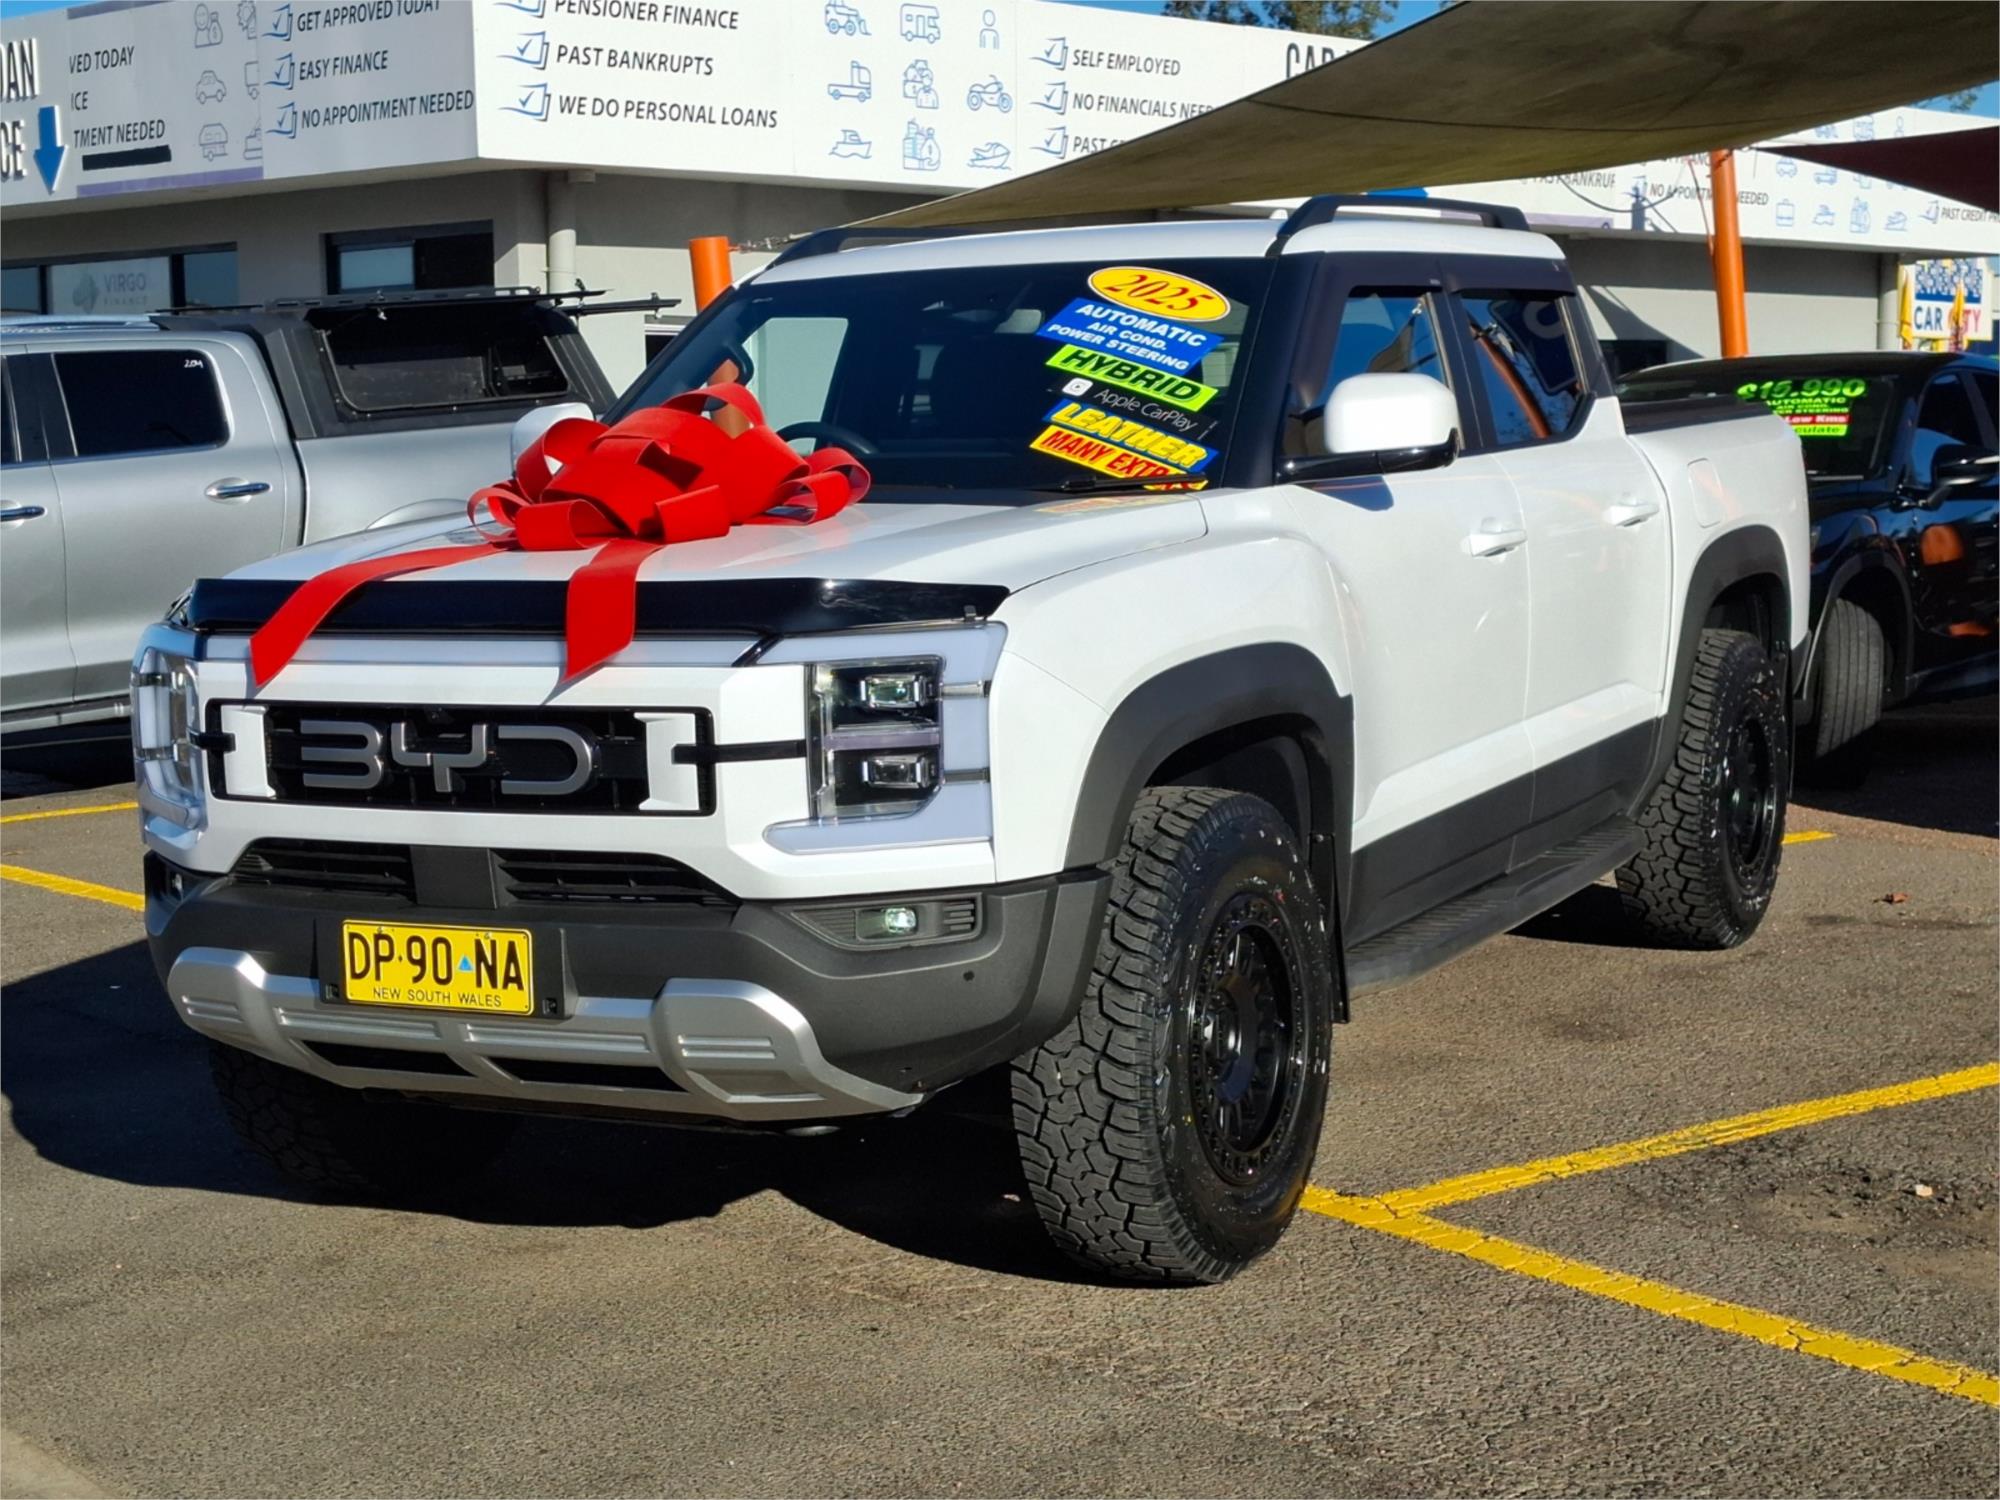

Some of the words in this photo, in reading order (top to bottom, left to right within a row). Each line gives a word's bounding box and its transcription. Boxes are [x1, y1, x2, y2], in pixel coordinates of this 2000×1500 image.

[297, 11, 320, 31] GET
[323, 1, 393, 28] APPROVED
[555, 0, 659, 22] PENSIONER
[663, 5, 740, 30] FINANCE
[95, 46, 134, 69] TODAY
[299, 59, 330, 81] EASY
[333, 50, 389, 76] FINANCE
[556, 44, 604, 66] PAST
[607, 49, 714, 76] BANKRUPTS
[1073, 49, 1105, 68] SELF
[1107, 53, 1181, 76] EMPLOYED
[302, 109, 321, 129] NO
[323, 97, 417, 126] APPOINTMENT
[419, 90, 475, 115] NEEDED
[559, 95, 588, 115] WE
[591, 97, 620, 118] DO
[624, 100, 717, 124] PERSONAL
[721, 107, 778, 129] LOANS
[1073, 93, 1094, 111] NO
[1097, 95, 1177, 118] FINANCIALS
[74, 125, 113, 148] TMENT
[116, 119, 165, 143] NEEDED
[1650, 183, 1665, 197] NO
[1941, 207, 1961, 220] PAST
[104, 272, 146, 292] VIRGO
[1104, 274, 1214, 311] 2025
[1075, 304, 1207, 347] AUTOMATIC
[1914, 305, 1943, 331] CAR
[1048, 324, 1106, 345] POWER
[1105, 340, 1190, 370] STEERING
[1087, 321, 1119, 336] AIR
[1119, 330, 1168, 350] COND.
[1060, 350, 1202, 401] HYBRID
[1094, 389, 1141, 411] Apple
[1141, 402, 1198, 432] CarPlay
[1041, 430, 1112, 464] MANY
[1051, 402, 1208, 469] LEATHER
[301, 719, 593, 796] BYD
[373, 987, 401, 1000] NEW
[407, 989, 451, 1003] SOUTH
[458, 993, 502, 1007] WALES
